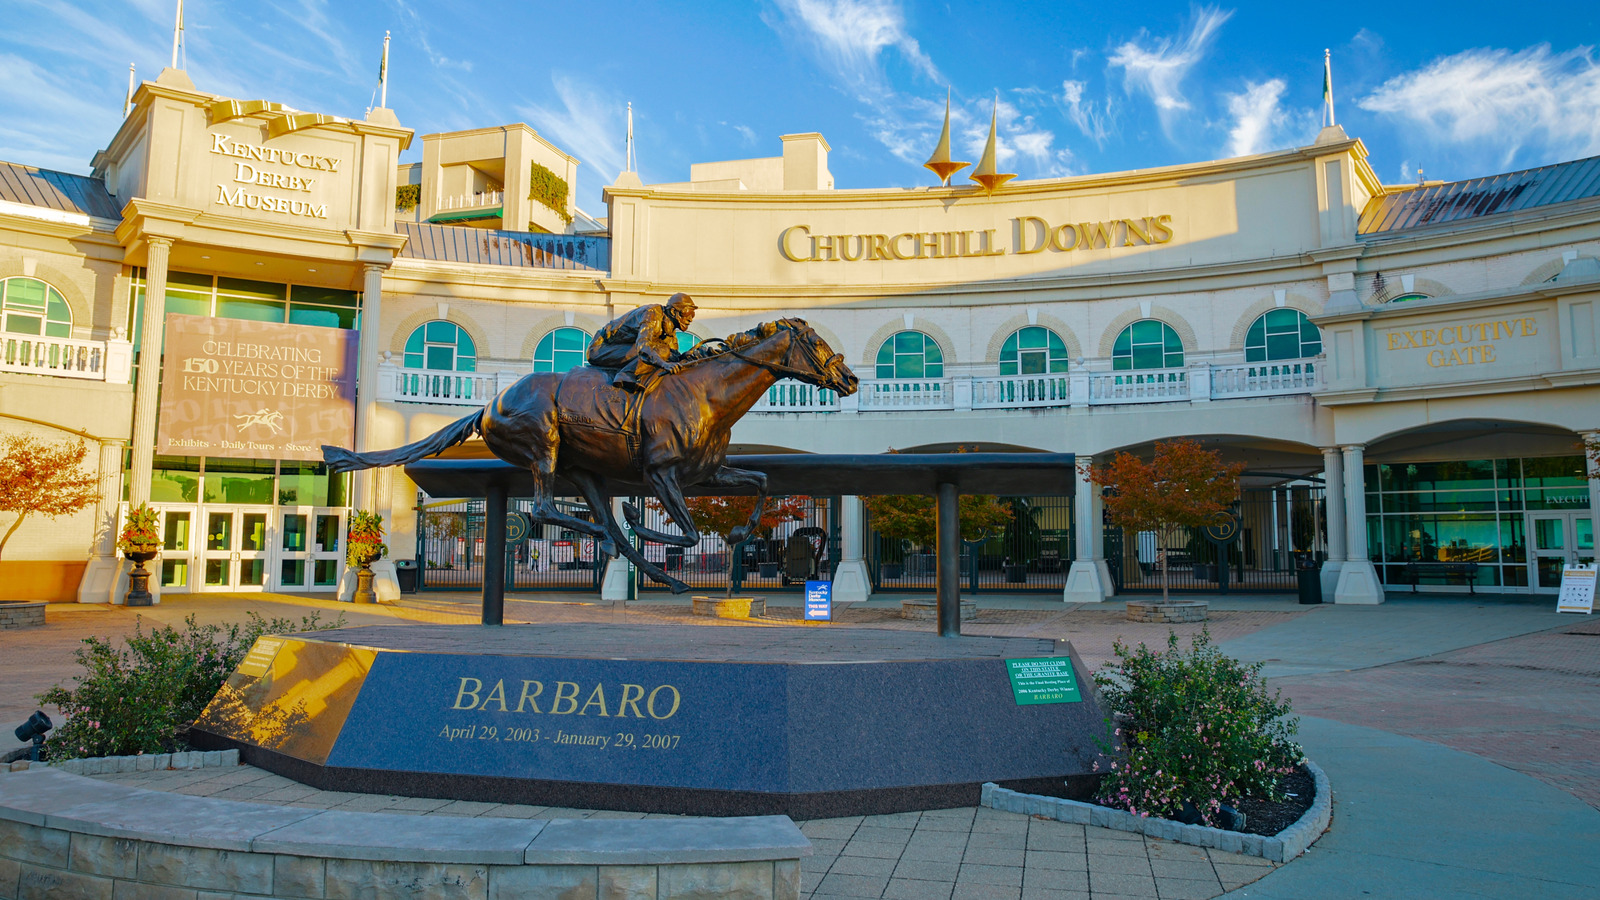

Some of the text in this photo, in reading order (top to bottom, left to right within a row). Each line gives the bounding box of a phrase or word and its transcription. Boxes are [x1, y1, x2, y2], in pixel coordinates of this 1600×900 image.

[210, 132, 341, 172] KENTUCKY
[233, 161, 316, 193] DERBY
[215, 184, 328, 219] MUSEUM
[781, 214, 1174, 262] CHURCHILL DOWNS
[1386, 317, 1538, 350] EXECUTIVE
[202, 340, 321, 363] CELEBRATING
[1426, 344, 1497, 368] GATE
[182, 357, 339, 382] 150 YEARS OF THE
[183, 375, 339, 399] KENTUCKY DERBY
[168, 437, 312, 452] Exhibits Daily Tours Store
[1545, 495, 1591, 504] EXECUTI
[450, 677, 681, 720] BARBARO
[438, 724, 476, 742] April
[478, 726, 500, 742] 29,
[503, 727, 540, 743] 2003
[553, 730, 611, 750] January
[614, 732, 637, 750] 29,
[642, 734, 681, 750] 2007
